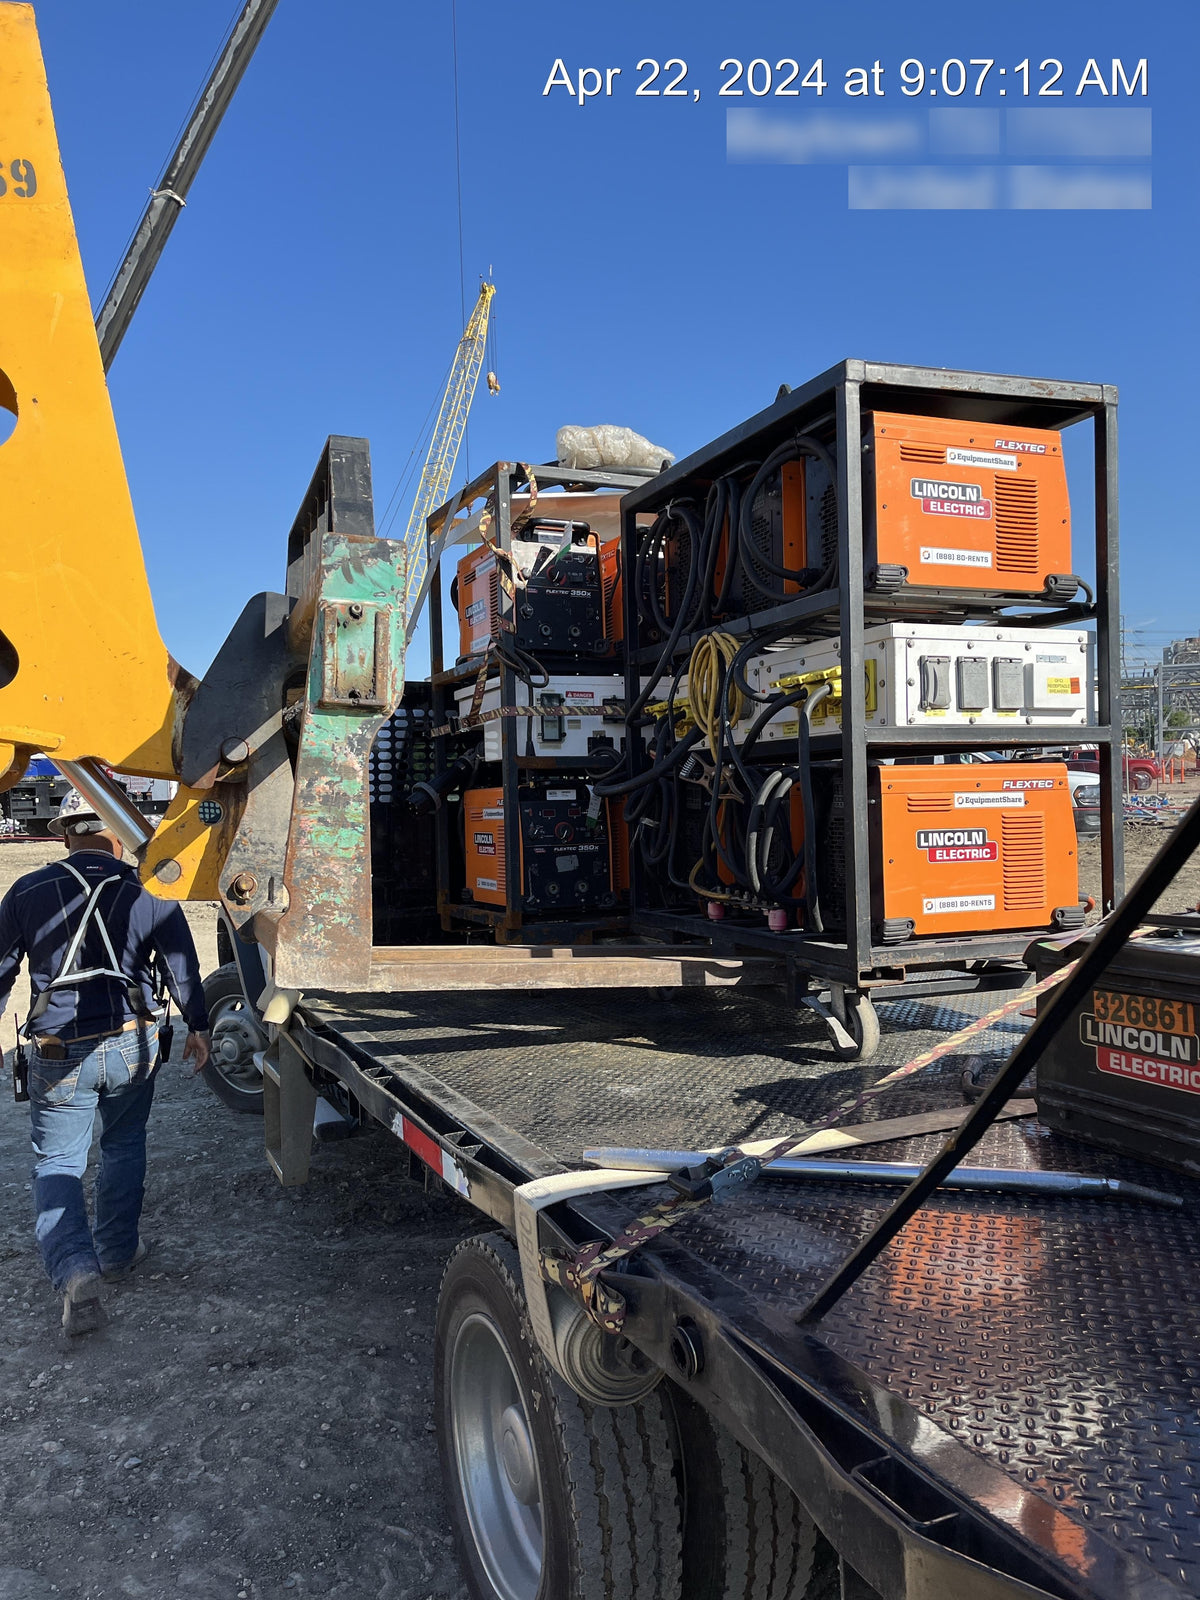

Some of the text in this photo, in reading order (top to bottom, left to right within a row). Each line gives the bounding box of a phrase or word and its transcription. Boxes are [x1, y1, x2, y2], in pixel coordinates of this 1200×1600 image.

[0, 158, 38, 198] 9
[995, 440, 1046, 453] FLEXTEC
[957, 453, 1015, 467] EquipmentShare
[914, 481, 978, 501] LINCOLN
[929, 501, 985, 516] ELECTRIC
[1003, 780, 1054, 789] FLEXTEC
[965, 796, 1023, 805] EquipmentShare
[920, 831, 984, 847] LINCOLN
[935, 848, 991, 860] ELECTRIC
[939, 901, 958, 909] (888)
[1096, 992, 1189, 1032] 326861
[1086, 1020, 1191, 1061] LINCOLN
[1109, 1052, 1200, 1087] ELECTRIC
